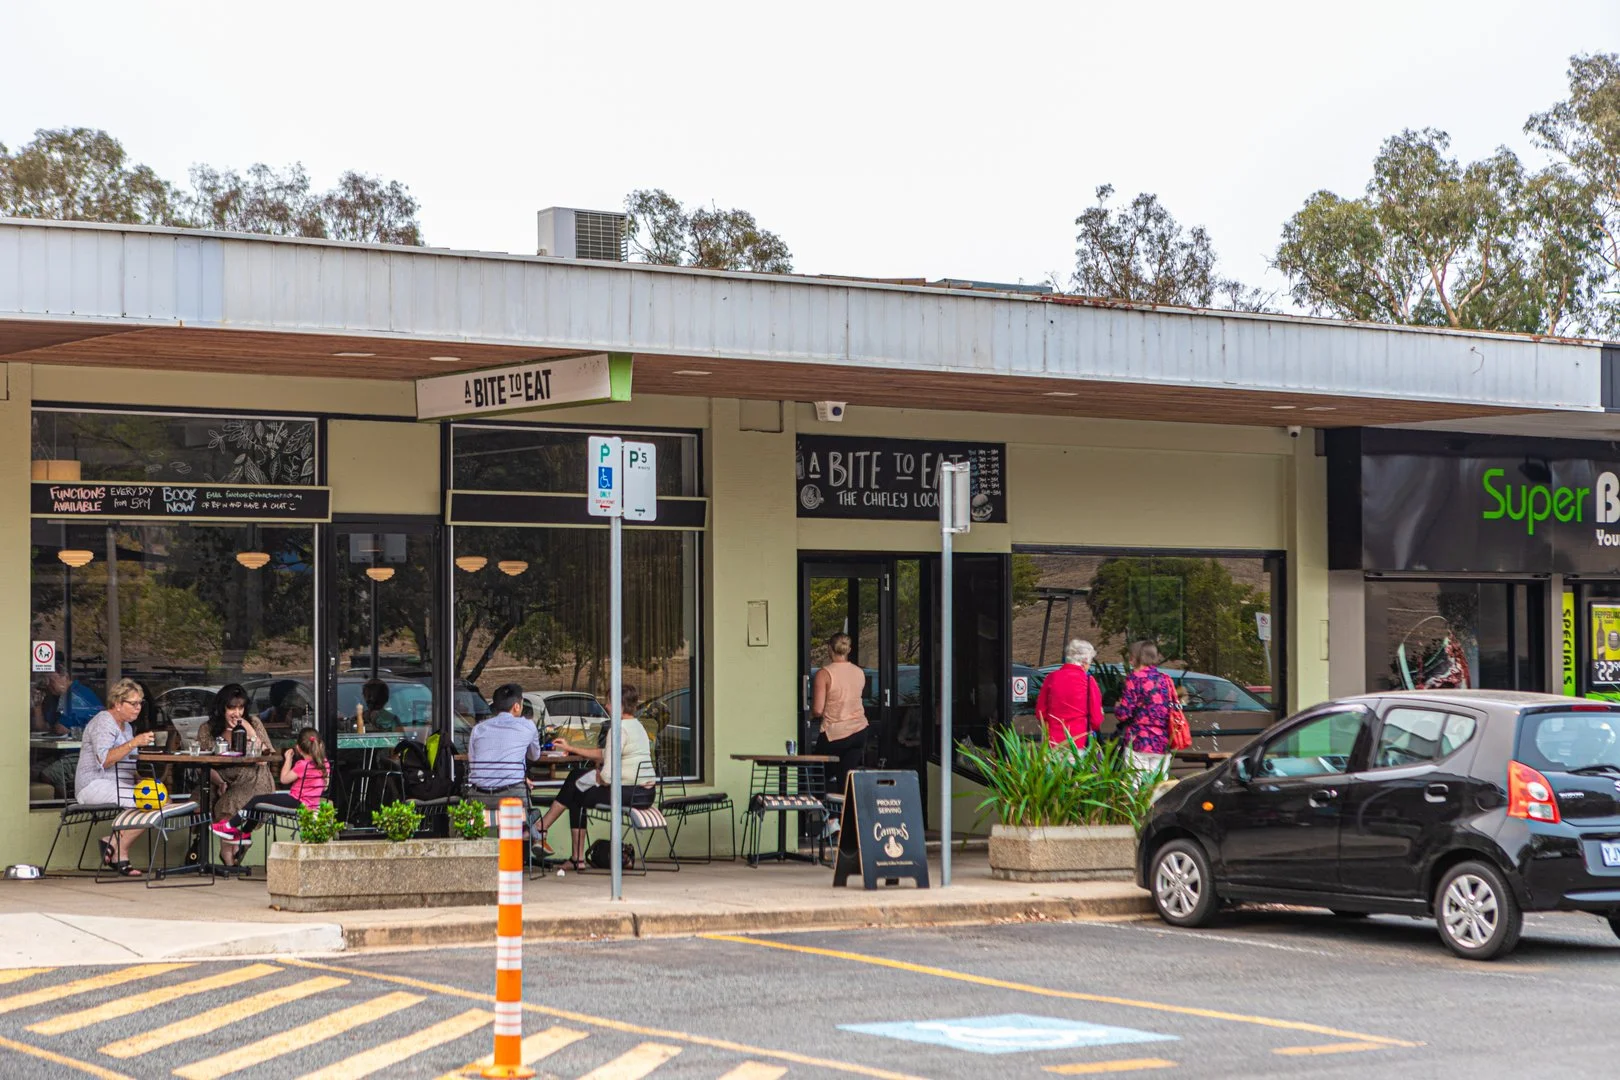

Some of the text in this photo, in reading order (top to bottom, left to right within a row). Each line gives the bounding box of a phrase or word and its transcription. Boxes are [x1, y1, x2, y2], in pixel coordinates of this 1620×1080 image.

[464, 369, 552, 408] A BITE TO EAT
[600, 444, 611, 463] P
[629, 450, 648, 469] P 5
[809, 451, 963, 490] A BITE TO EA
[49, 486, 106, 501] FUNCTIONS
[138, 486, 155, 496] DAY
[161, 486, 198, 502] BOOK
[836, 490, 940, 508] THE CHIFLEY LOCA
[53, 500, 103, 513] AVAILABLE
[129, 497, 151, 511] 5PM
[165, 500, 196, 513] NOW
[1482, 468, 1591, 535] Super
